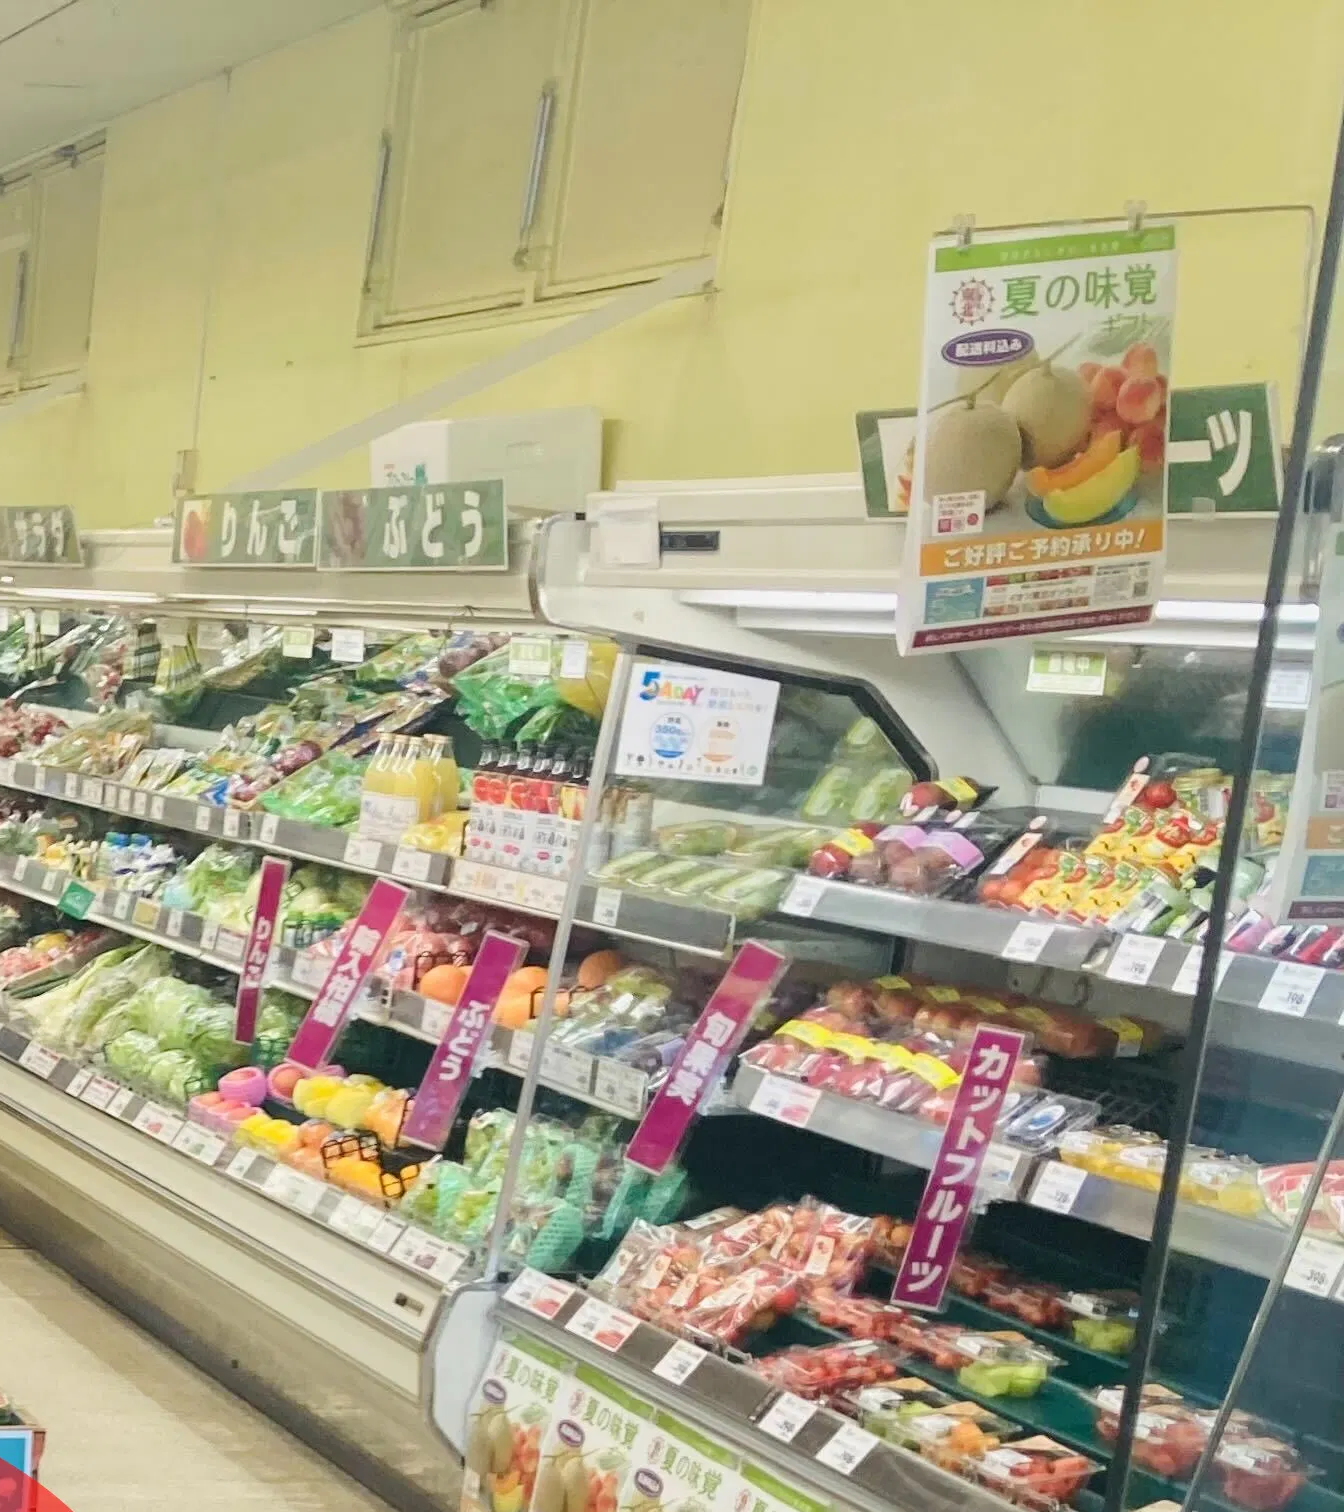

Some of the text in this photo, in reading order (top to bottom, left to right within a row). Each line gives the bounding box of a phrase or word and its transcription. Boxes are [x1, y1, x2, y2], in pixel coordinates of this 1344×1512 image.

[999, 263, 1158, 320] 夏の味覚
[220, 499, 302, 559] りんご
[382, 489, 484, 560] ぶどう
[438, 1000, 491, 1082] ぶどう
[905, 1042, 1012, 1295] カットフルーツ
[659, 1443, 723, 1500] 夏の味覚
